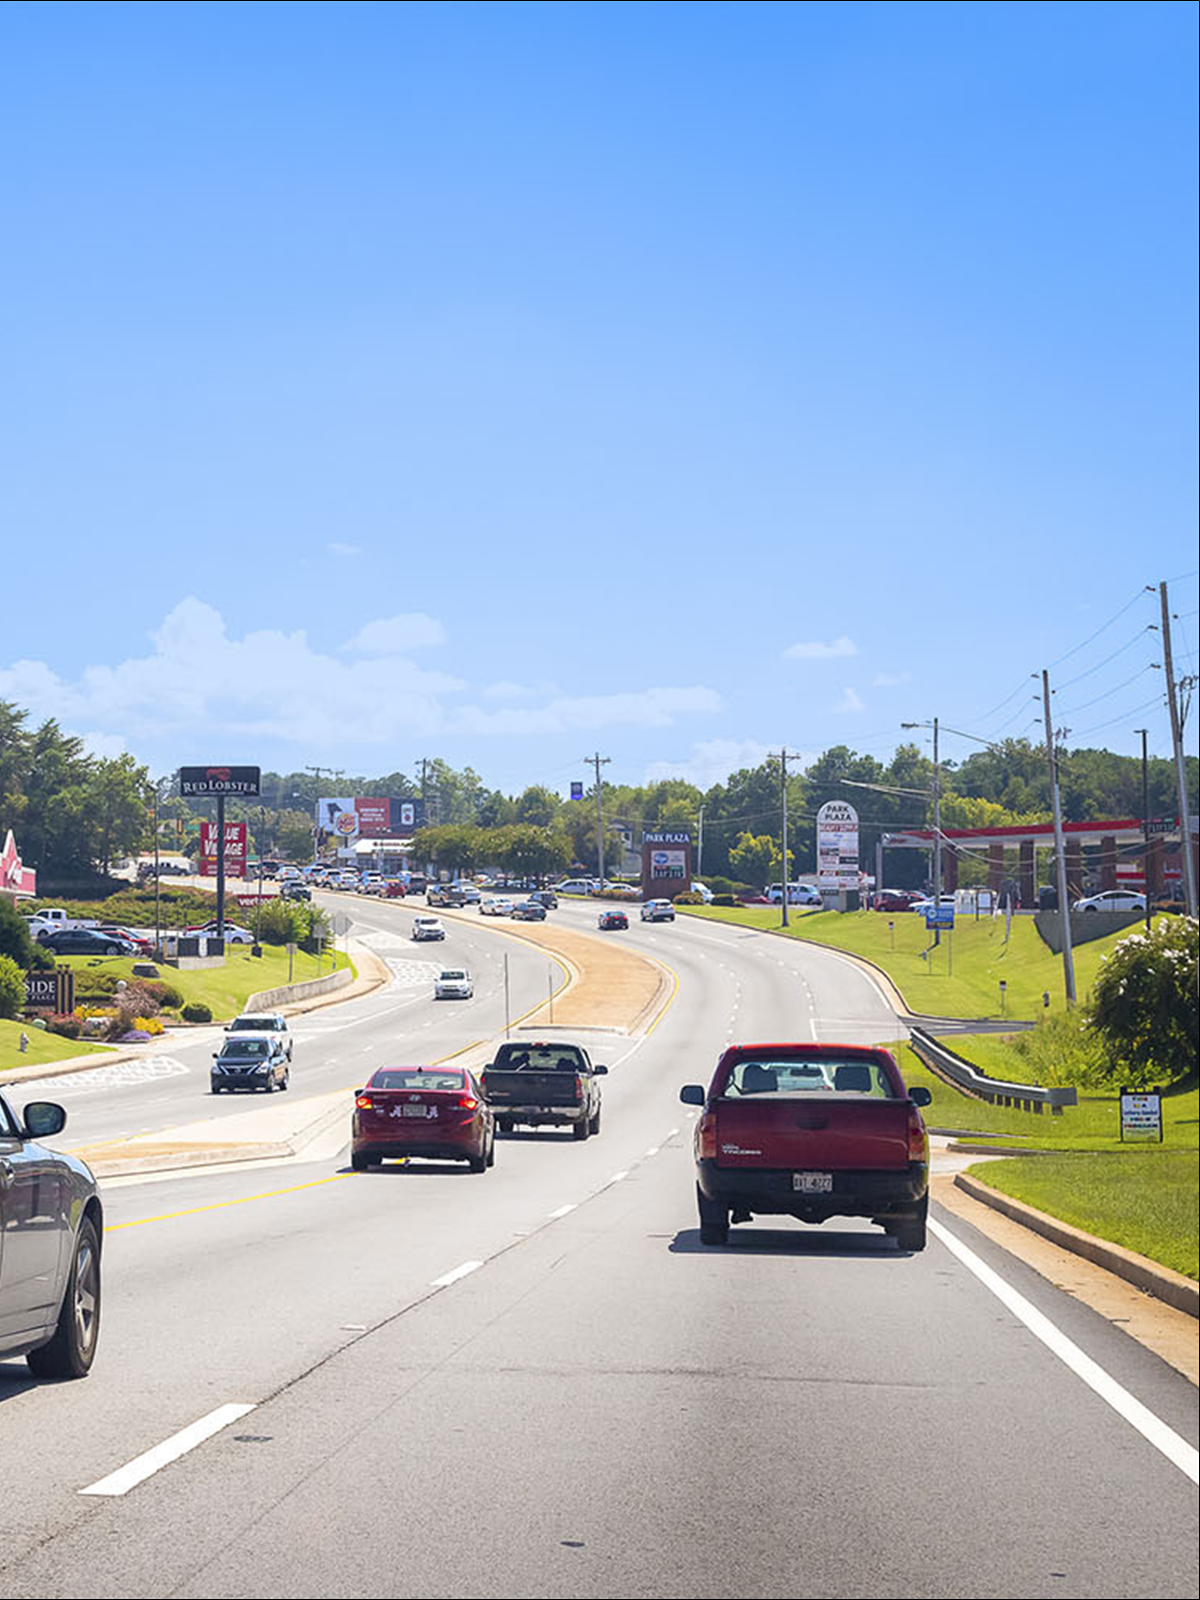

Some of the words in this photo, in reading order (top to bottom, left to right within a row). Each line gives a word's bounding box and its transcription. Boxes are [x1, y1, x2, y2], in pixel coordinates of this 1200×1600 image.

[183, 782, 207, 793] RED
[209, 780, 257, 793] LOBSTER
[646, 833, 664, 842] PARK
[665, 833, 689, 842] PLAZA
